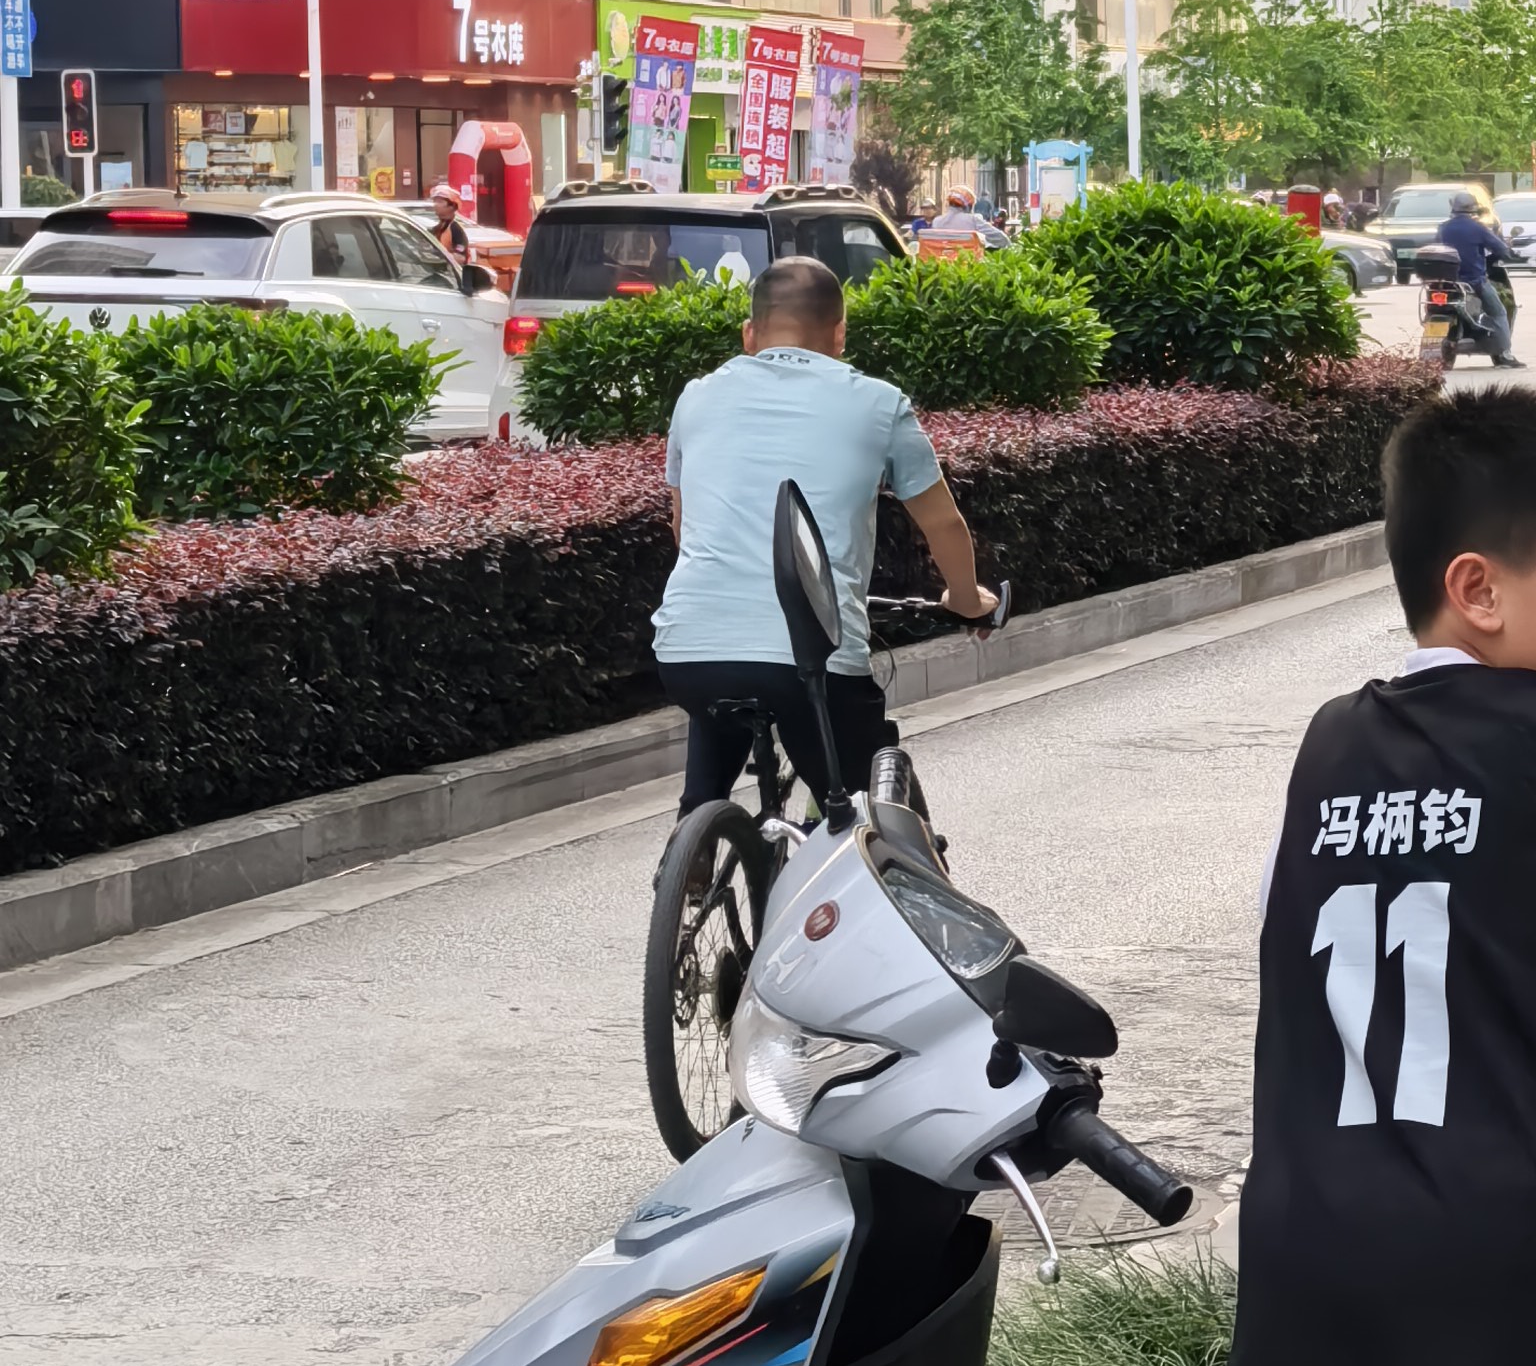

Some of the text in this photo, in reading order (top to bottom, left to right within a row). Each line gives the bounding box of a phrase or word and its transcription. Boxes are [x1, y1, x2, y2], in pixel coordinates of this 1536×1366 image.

[643, 27, 695, 56] 7号衣库
[751, 38, 798, 63] 7号衣库
[822, 41, 861, 67] 7号衣库
[763, 72, 793, 184] 服装超市
[1311, 787, 1482, 857] 冯柄钧
[1310, 881, 1451, 1127] 11
